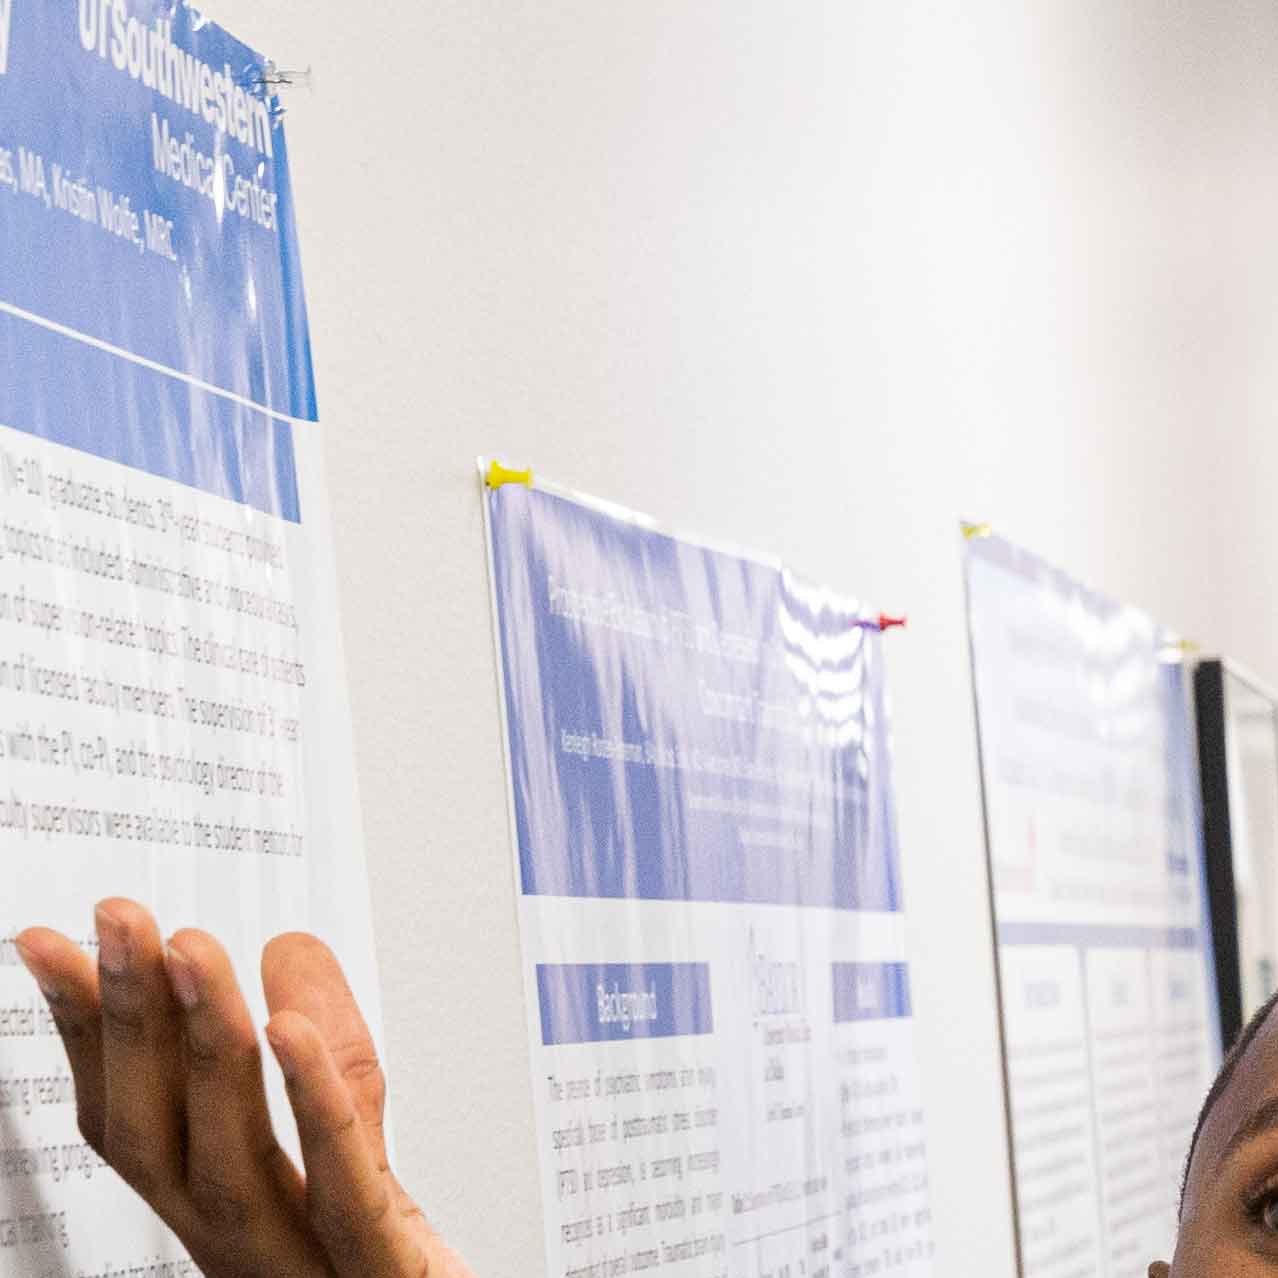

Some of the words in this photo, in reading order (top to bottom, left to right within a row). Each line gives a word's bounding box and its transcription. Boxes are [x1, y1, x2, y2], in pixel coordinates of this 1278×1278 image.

[19, 147, 52, 208] MA,
[52, 164, 97, 224] Kristin
[223, 155, 278, 232] Center
[596, 975, 657, 1031] Background
